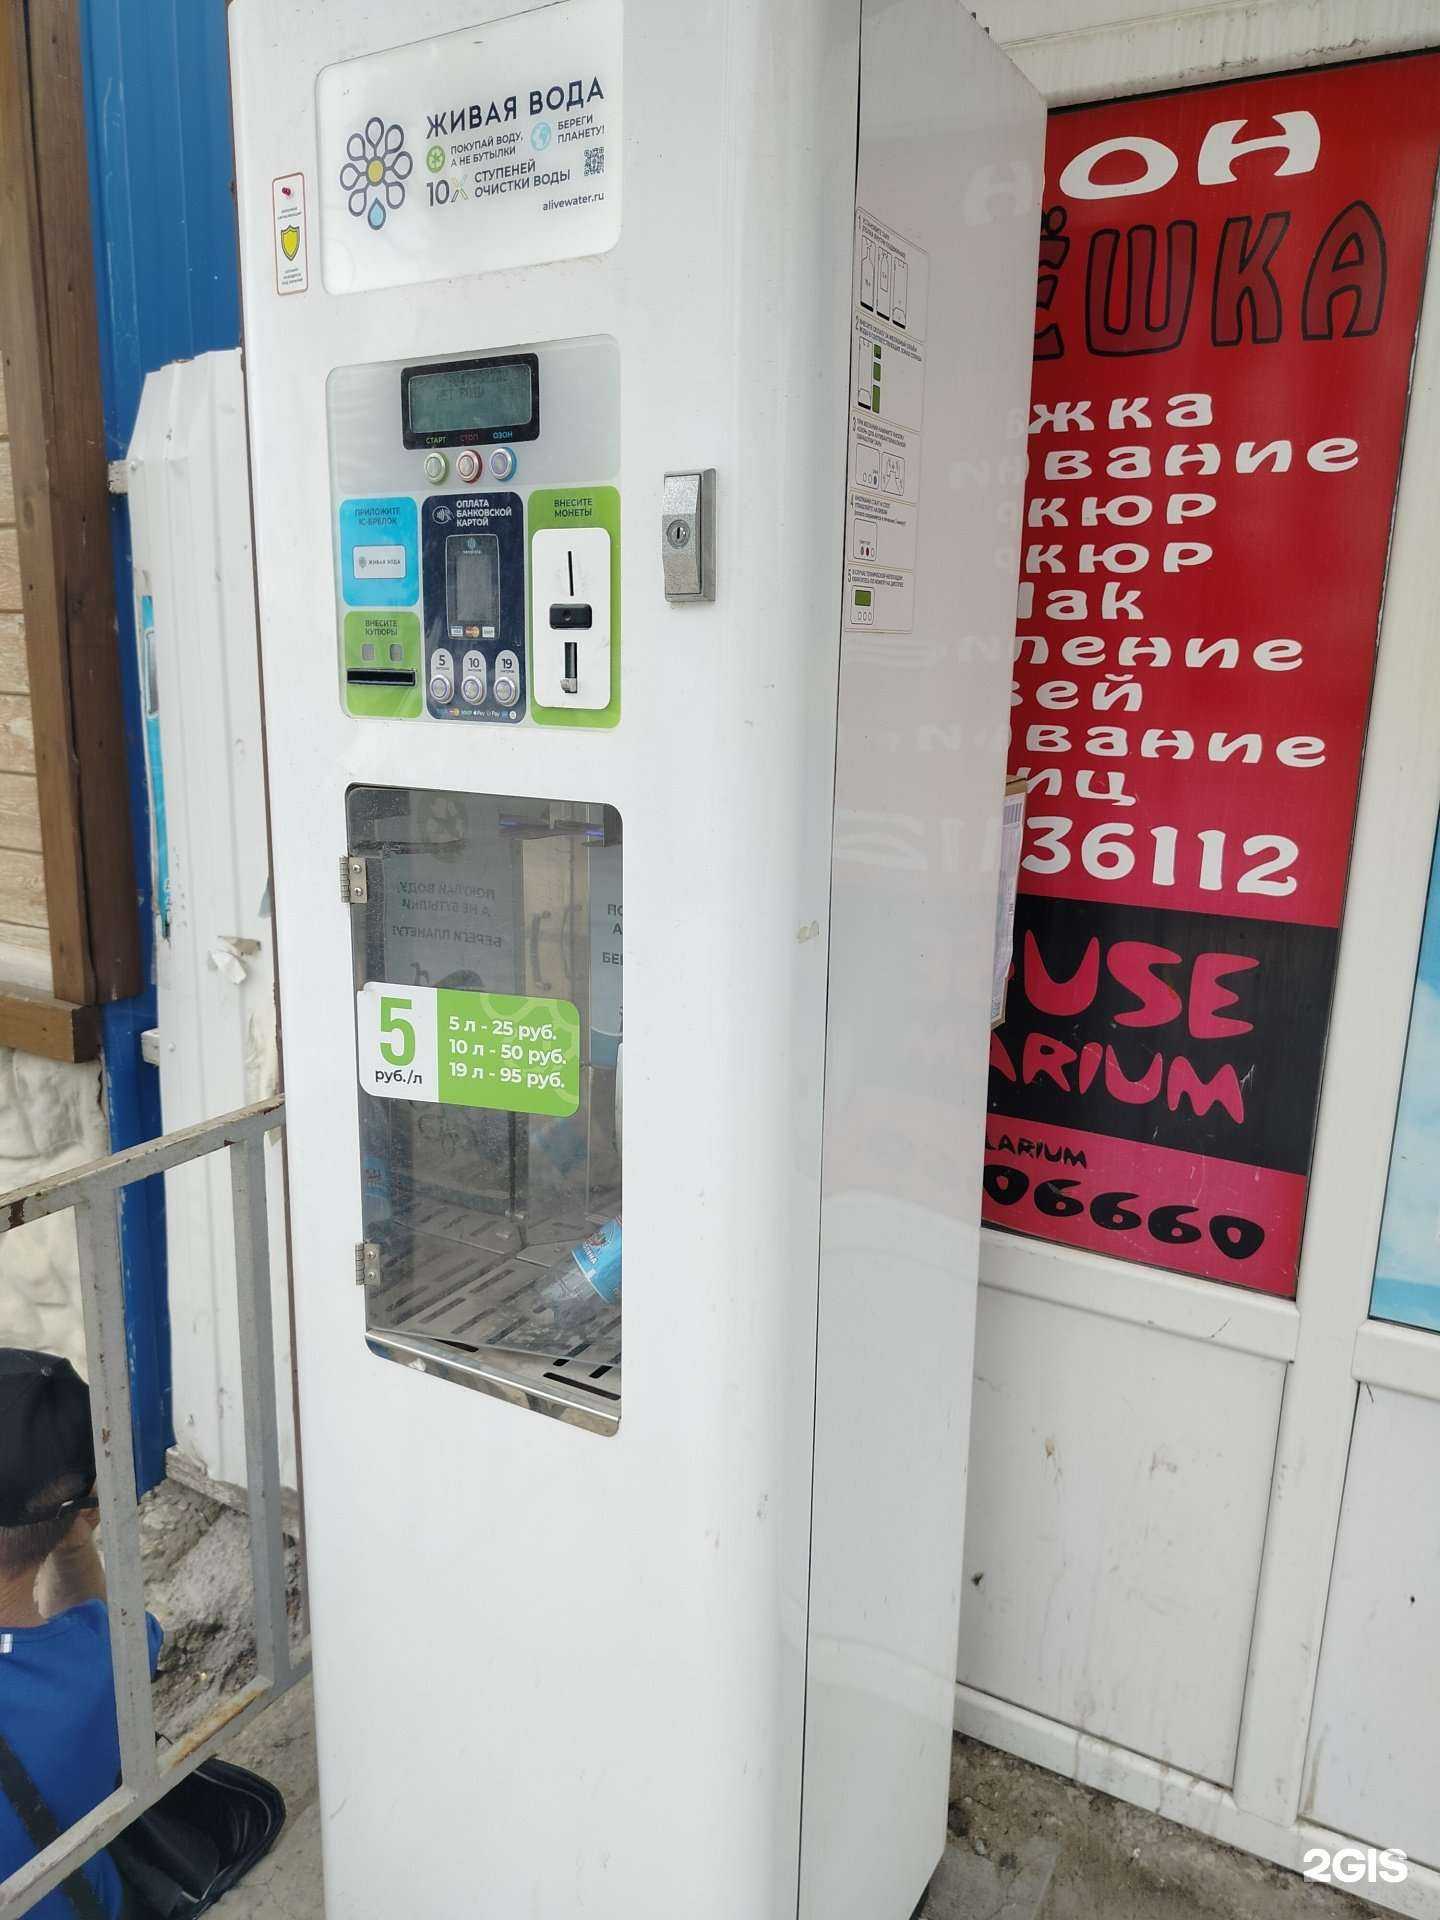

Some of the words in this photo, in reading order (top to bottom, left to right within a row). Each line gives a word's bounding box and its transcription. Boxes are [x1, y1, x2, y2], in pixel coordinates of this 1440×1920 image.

[426, 96, 517, 139] ЖИВАЯ
[529, 76, 604, 116] ВОДА
[558, 114, 593, 130] БЕРЕГИ
[451, 136, 493, 155] ПОКУПАЙ
[496, 131, 523, 147] ВОДУ,
[558, 125, 605, 143] ПЛАНЕТУ!
[451, 158, 458, 167] А
[459, 156, 471, 166] НЕ
[473, 146, 516, 163] БУТЫЛКИ
[1059, 110, 1321, 201] ОН
[475, 159, 536, 183] СТУПЕНЕЙ
[475, 178, 530, 198] ОЧИСТКИ
[534, 169, 570, 187] ВОДЫ
[543, 192, 604, 211] alivewater.ru
[1027, 393, 1213, 434] жка
[426, 436, 447, 444] СТАРТ
[493, 431, 513, 439] ОЗОН
[1044, 438, 1359, 481] вание
[355, 507, 400, 516] ПРИЛОЖИТЕ
[456, 506, 512, 518] БАНКОВСКОЙ
[457, 499, 489, 508] ОПЛАТА
[554, 498, 593, 508] ВНЕСИТЕ
[554, 508, 592, 517] МОНЕТЫ
[1028, 493, 1217, 527] кюр
[457, 516, 488, 527] КАРТОЙ
[1025, 542, 1213, 573] кюр
[365, 619, 398, 628] ВНЕСИТЕ
[365, 628, 398, 636] КУПЮРЫ
[439, 655, 446, 666] 5
[468, 658, 480, 668] 10
[501, 658, 512, 669] 19
[1026, 724, 1327, 768] вание
[1021, 815, 1299, 896] 36112
[1010, 929, 1260, 1039] USE
[380, 996, 416, 1067] 5
[449, 1016, 459, 1031] 5
[463, 1020, 476, 1033] л
[492, 1019, 513, 1036] 25
[518, 1024, 557, 1041] руб.
[449, 1038, 468, 1055] 10
[471, 1043, 484, 1056] л
[500, 1045, 523, 1060] 50
[528, 1048, 567, 1065] руб.
[375, 1068, 423, 1084] руб./л
[449, 1062, 468, 1078] 19
[471, 1067, 484, 1080] л
[500, 1067, 522, 1083] 95
[527, 1072, 565, 1089] руб.
[983, 1164, 1265, 1260] 06660
